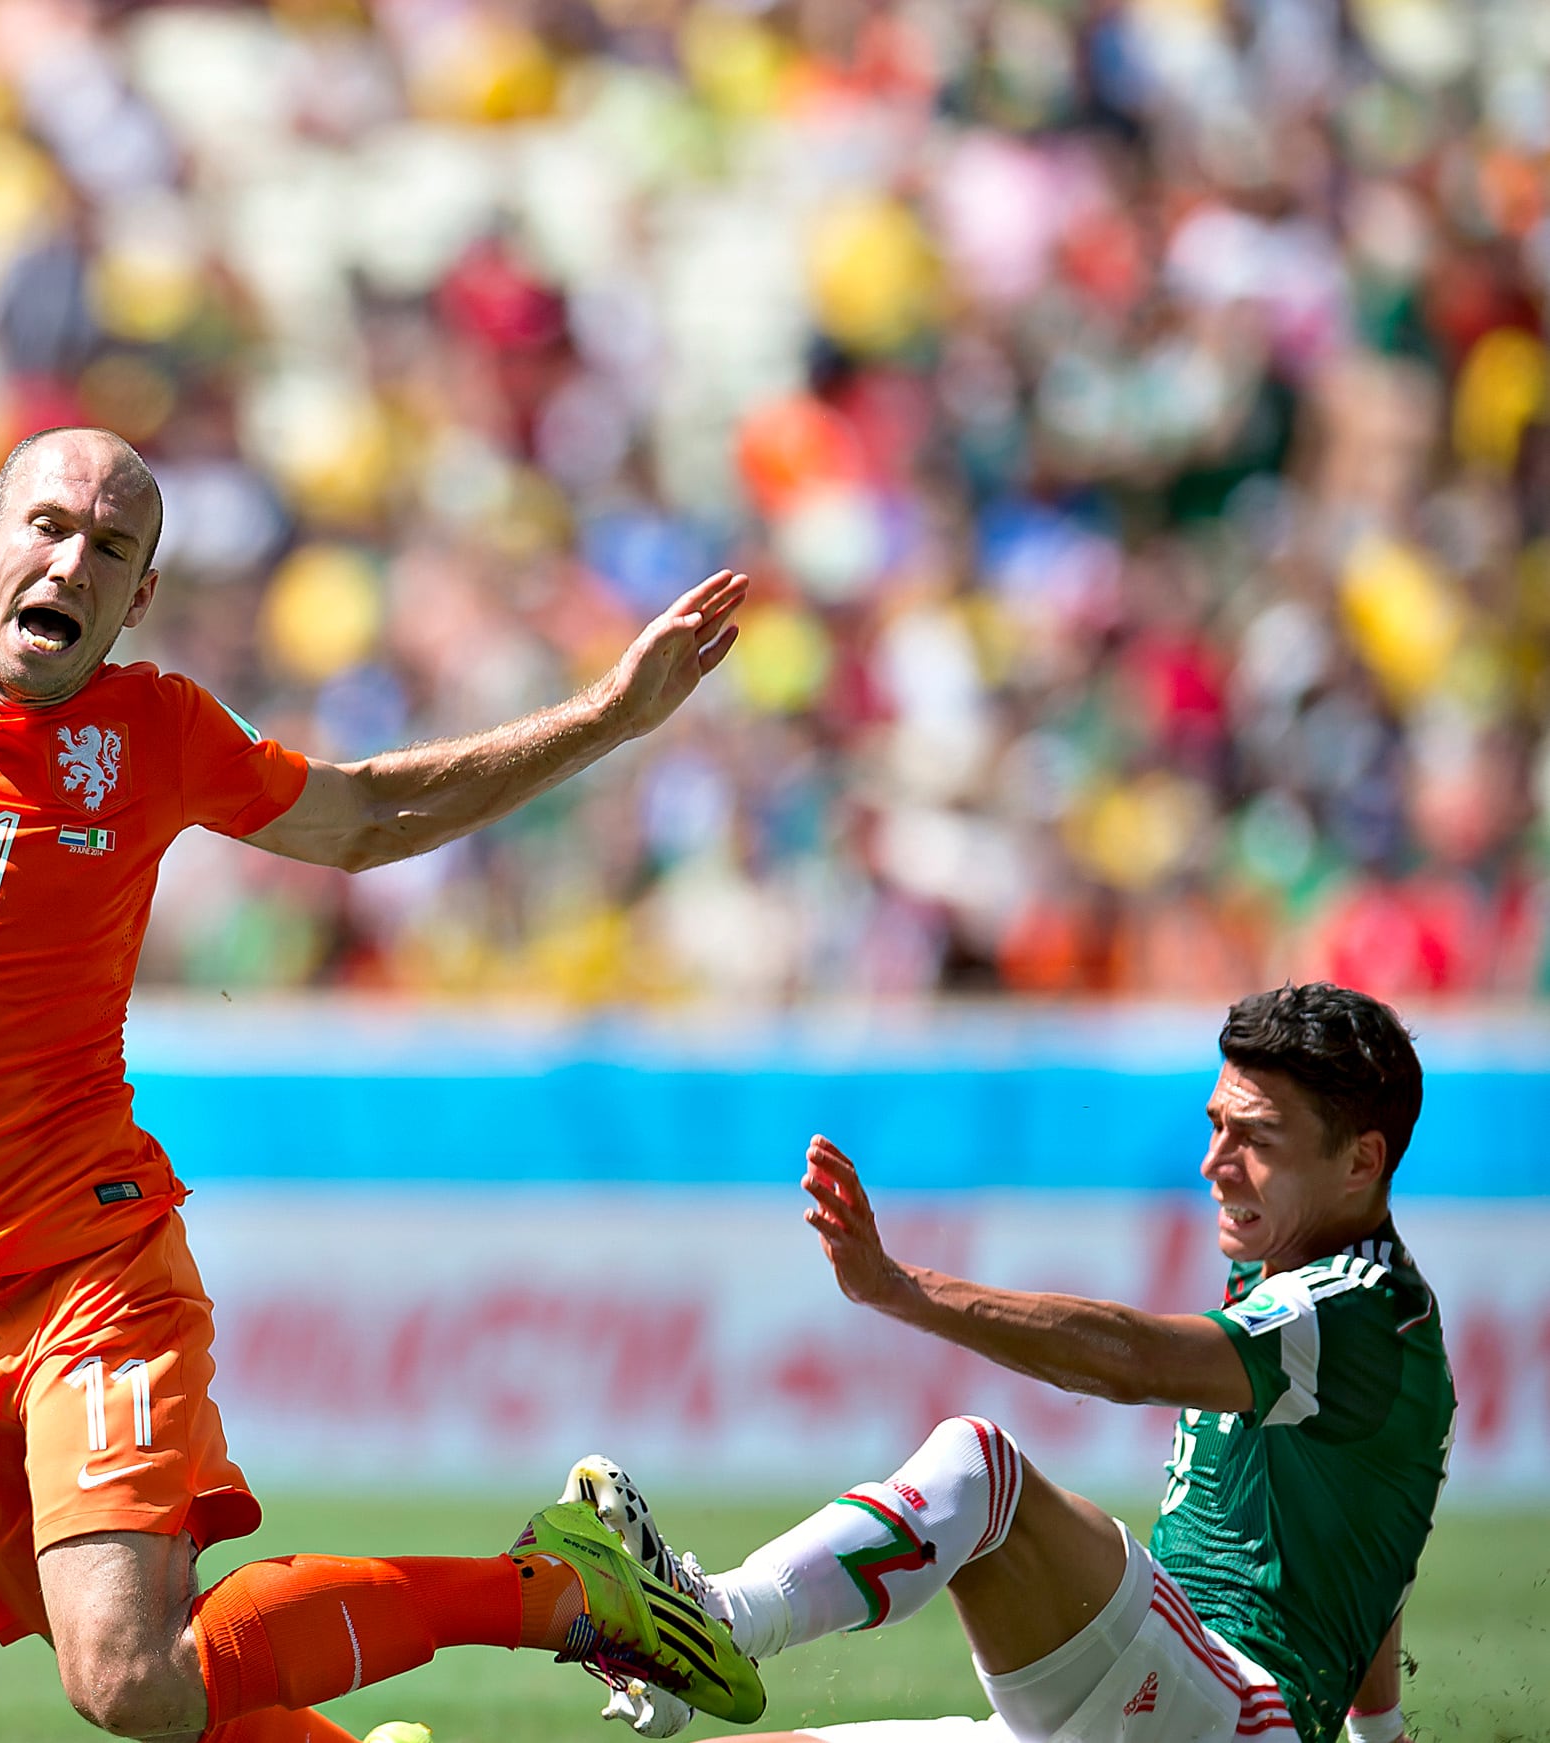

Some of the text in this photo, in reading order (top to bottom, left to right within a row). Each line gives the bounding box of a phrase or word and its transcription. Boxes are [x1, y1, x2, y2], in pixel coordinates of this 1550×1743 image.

[69, 845, 103, 857] 29 JUNE 2014
[63, 1355, 152, 1451] 11
